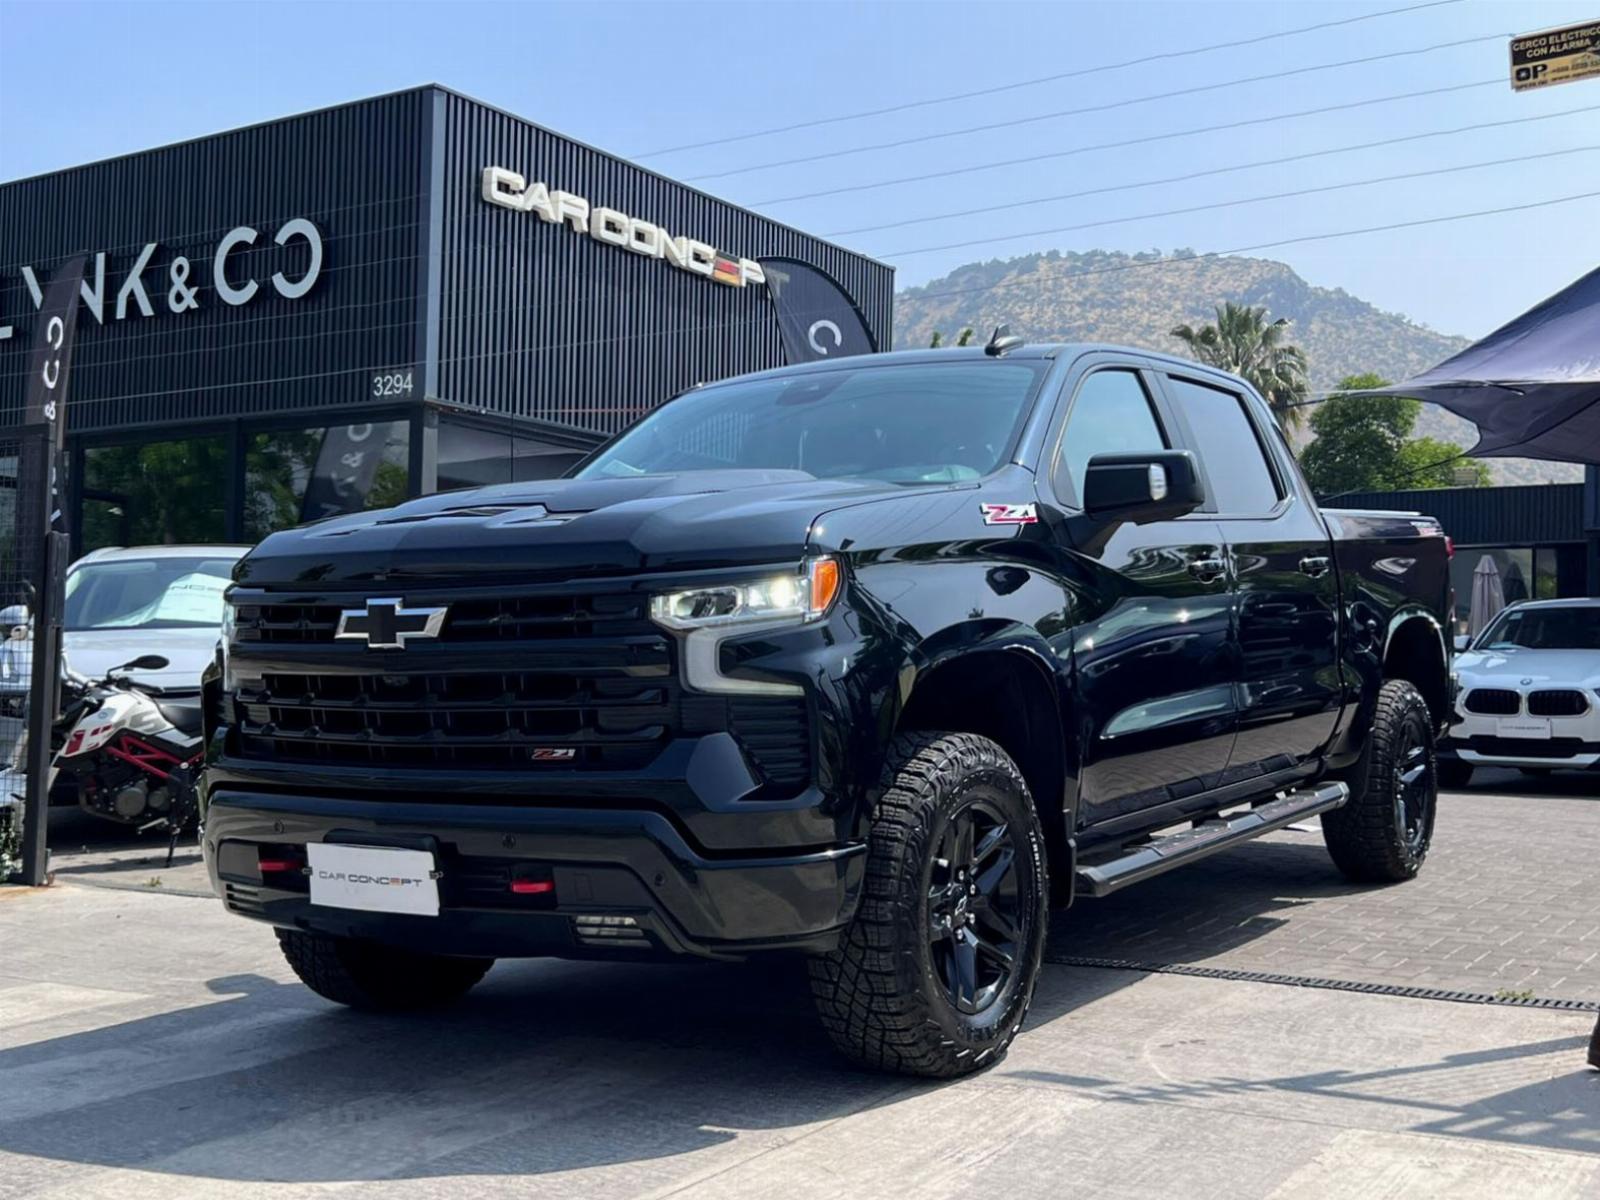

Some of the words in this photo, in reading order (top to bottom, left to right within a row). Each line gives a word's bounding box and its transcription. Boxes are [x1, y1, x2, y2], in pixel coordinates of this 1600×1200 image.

[1513, 38, 1546, 51] CERCO
[1526, 47, 1547, 58] CON
[1549, 38, 1590, 53] ALARMA
[482, 165, 590, 233] CAR
[373, 373, 413, 396] 3294
[319, 871, 346, 881] CAR
[348, 874, 422, 887] CONCEPT
